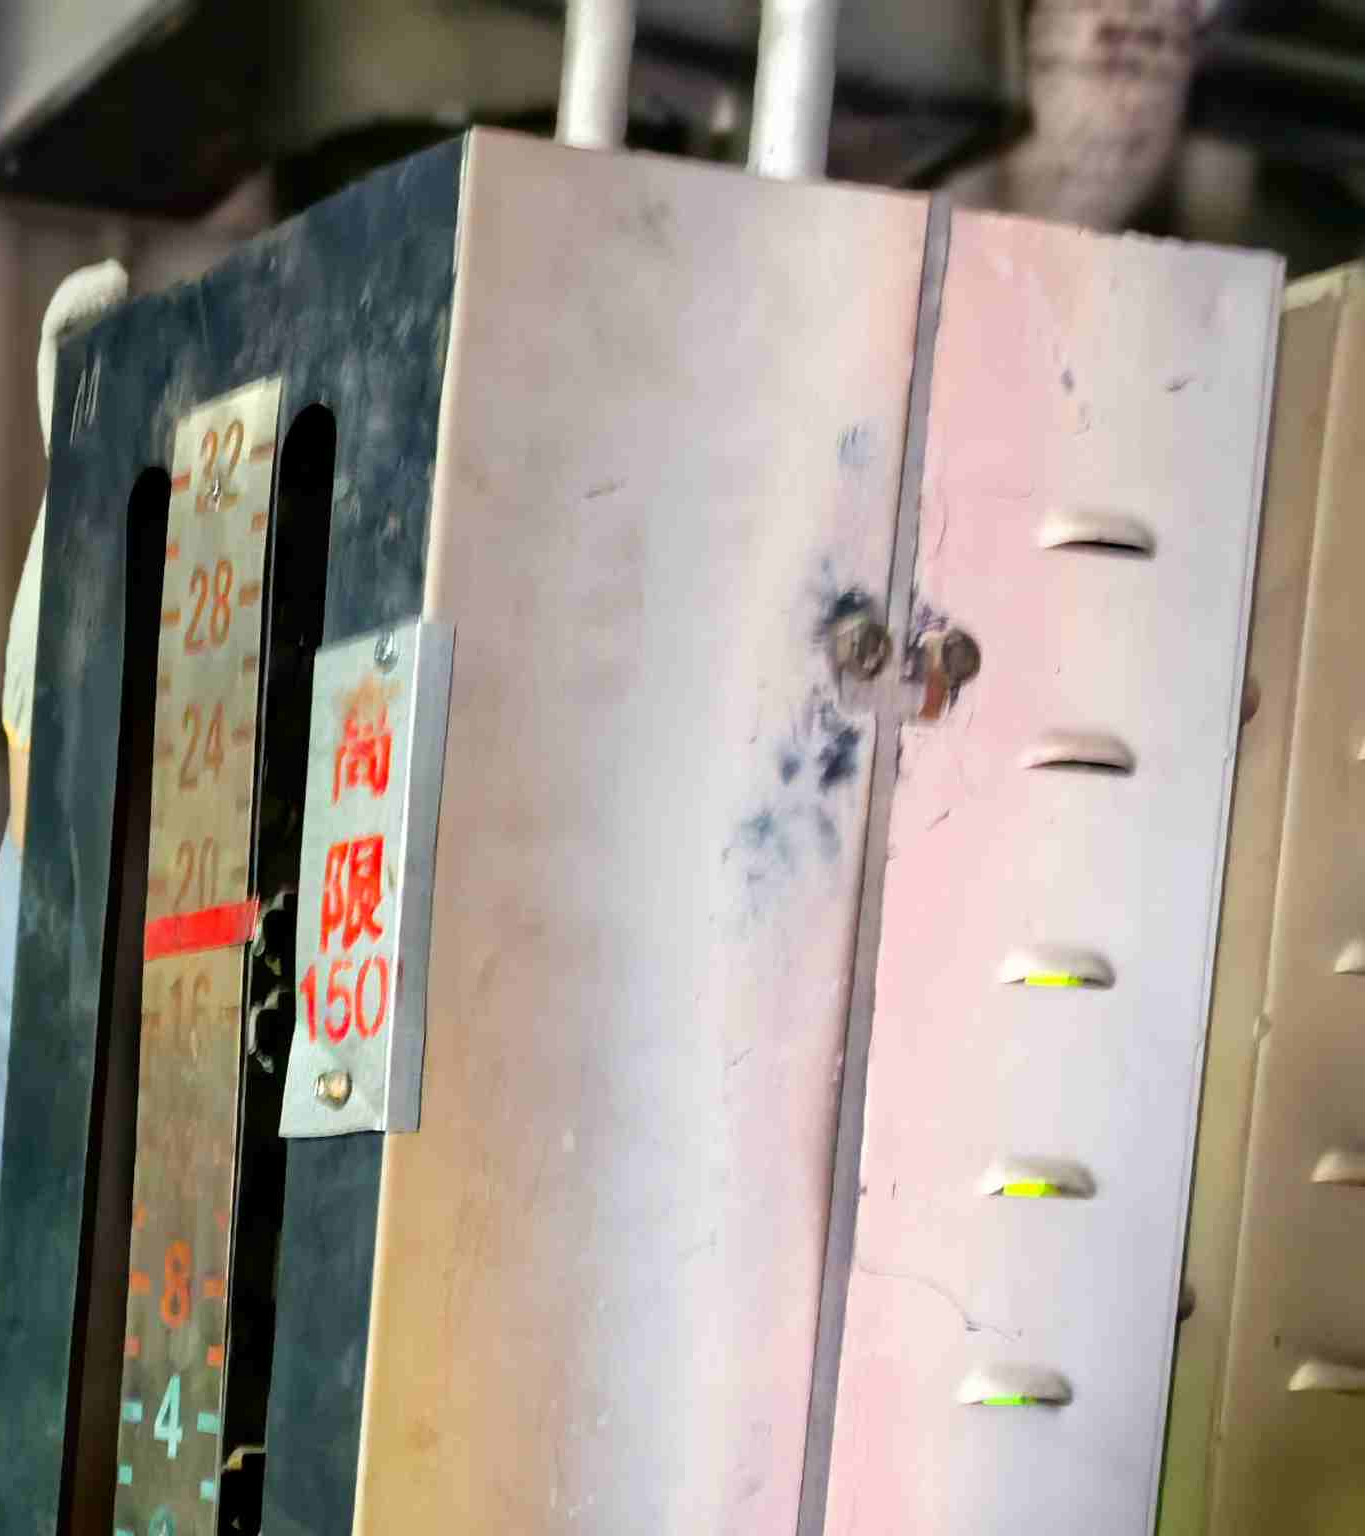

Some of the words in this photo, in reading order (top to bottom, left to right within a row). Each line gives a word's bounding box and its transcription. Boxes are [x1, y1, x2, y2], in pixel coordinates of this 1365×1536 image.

[184, 559, 233, 655] 28
[177, 702, 226, 791] 24
[299, 954, 389, 1045] 150
[159, 1239, 192, 1329] 8
[153, 1374, 183, 1460] 4
